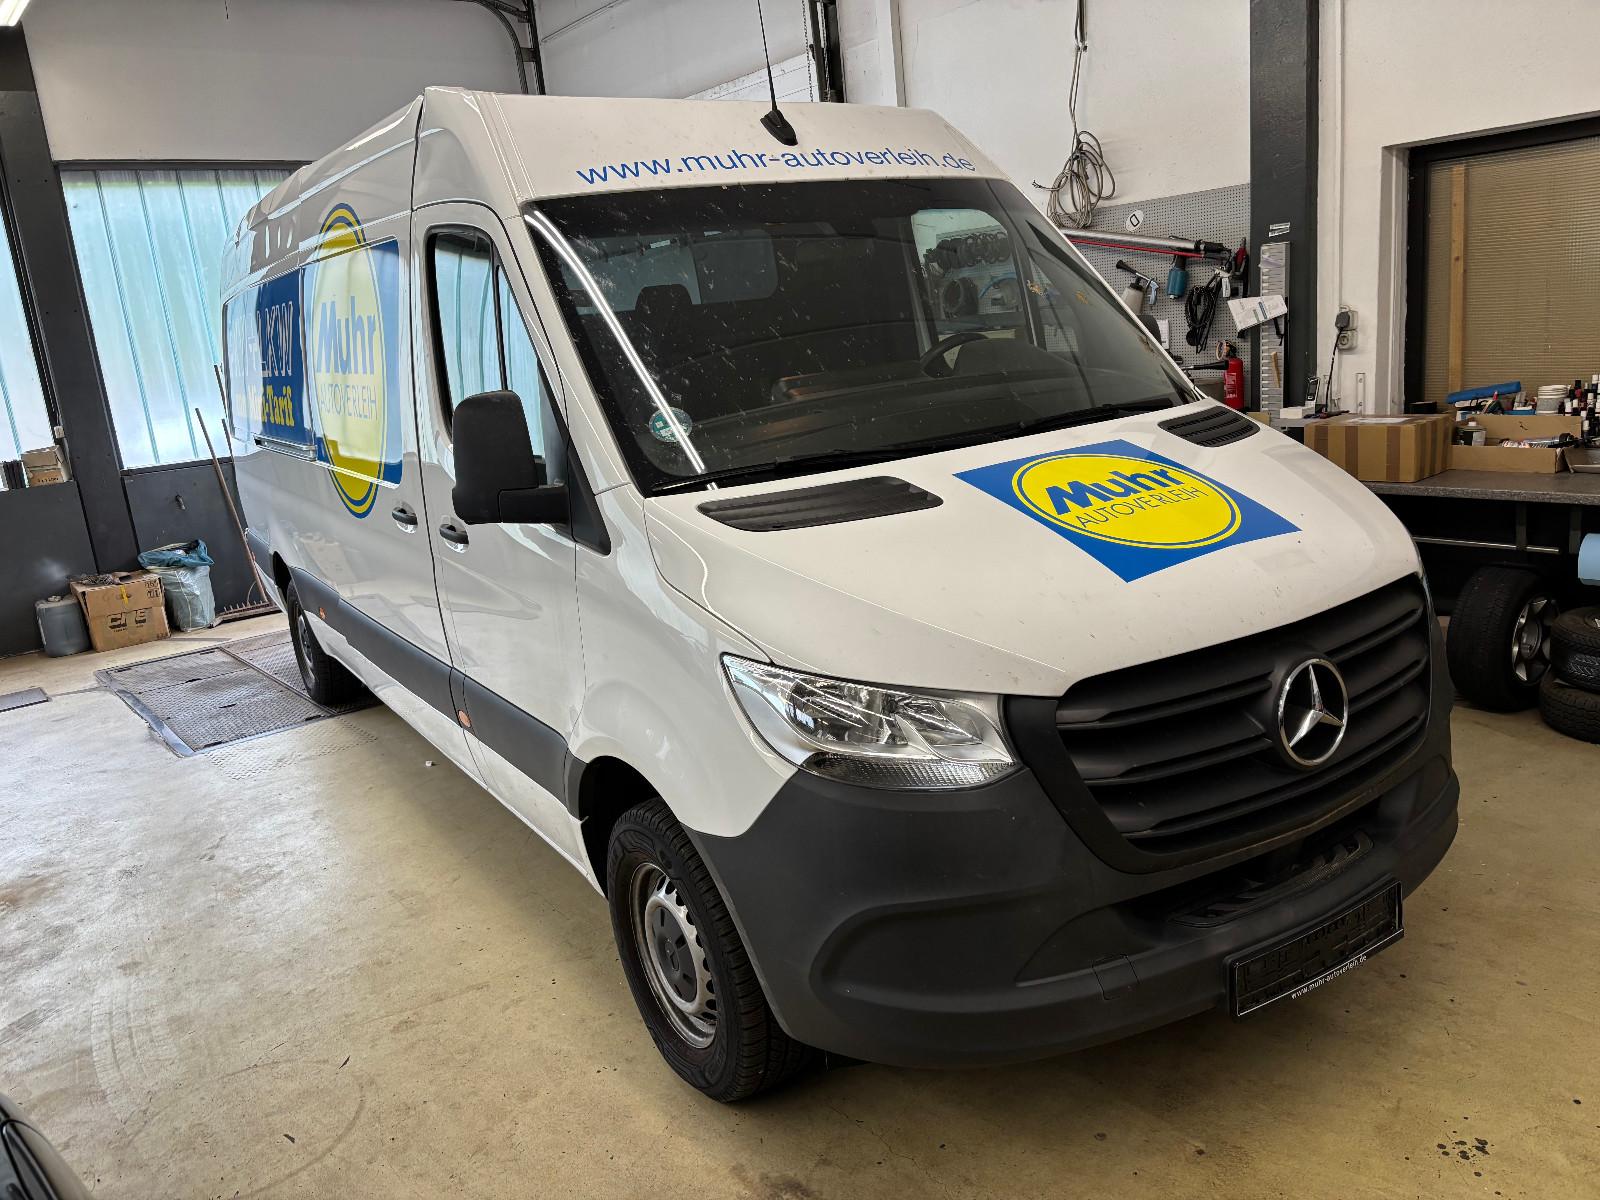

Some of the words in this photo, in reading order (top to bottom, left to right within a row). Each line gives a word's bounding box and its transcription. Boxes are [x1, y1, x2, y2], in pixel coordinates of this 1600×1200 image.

[576, 149, 976, 185] www.muhr-autoverleih.de
[316, 295, 377, 375] Muhr
[320, 383, 378, 421] AUTOVERLEIH
[1045, 468, 1185, 516] Muhr
[1075, 486, 1209, 528] AUTOVERLEIH
[1291, 954, 1367, 1000] www.muhr-autoverleih.de
